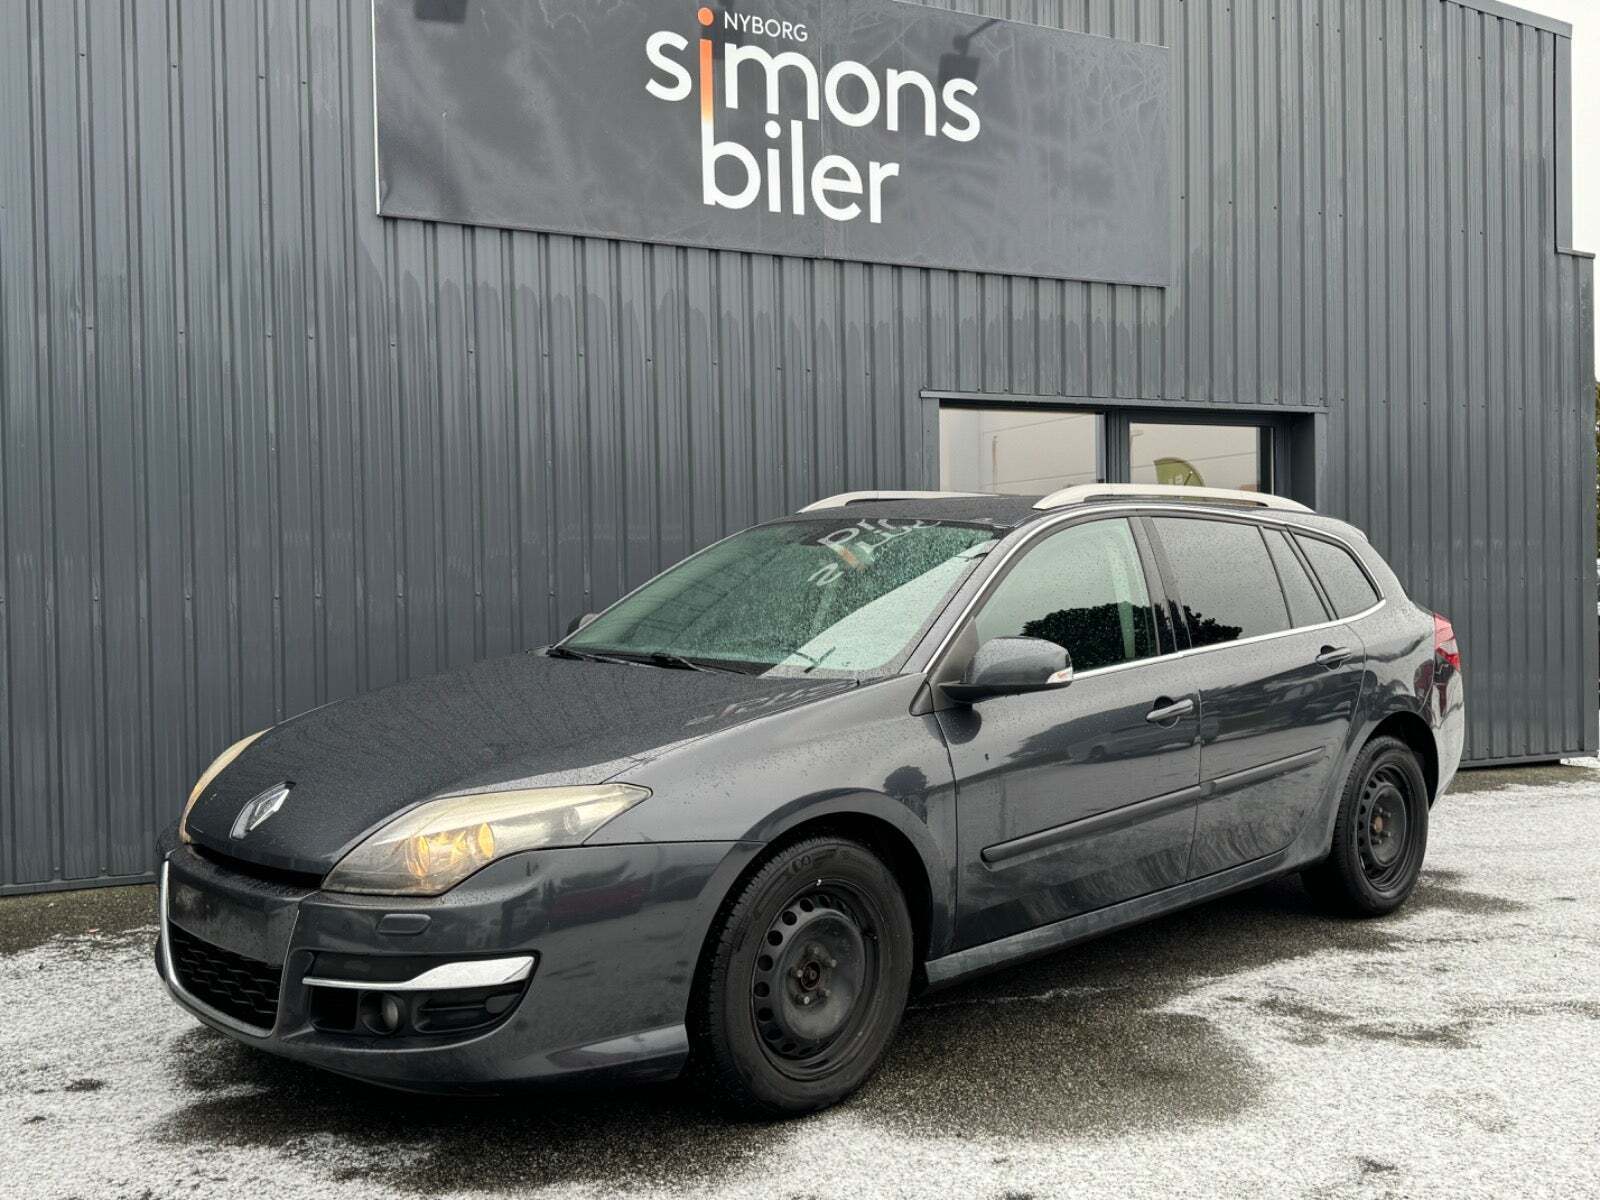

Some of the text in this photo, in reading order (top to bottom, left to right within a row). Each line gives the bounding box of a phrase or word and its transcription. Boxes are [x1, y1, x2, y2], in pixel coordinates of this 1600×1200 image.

[645, 7, 981, 142] simons
[724, 11, 808, 42] NYBORG
[700, 118, 899, 224] biler
